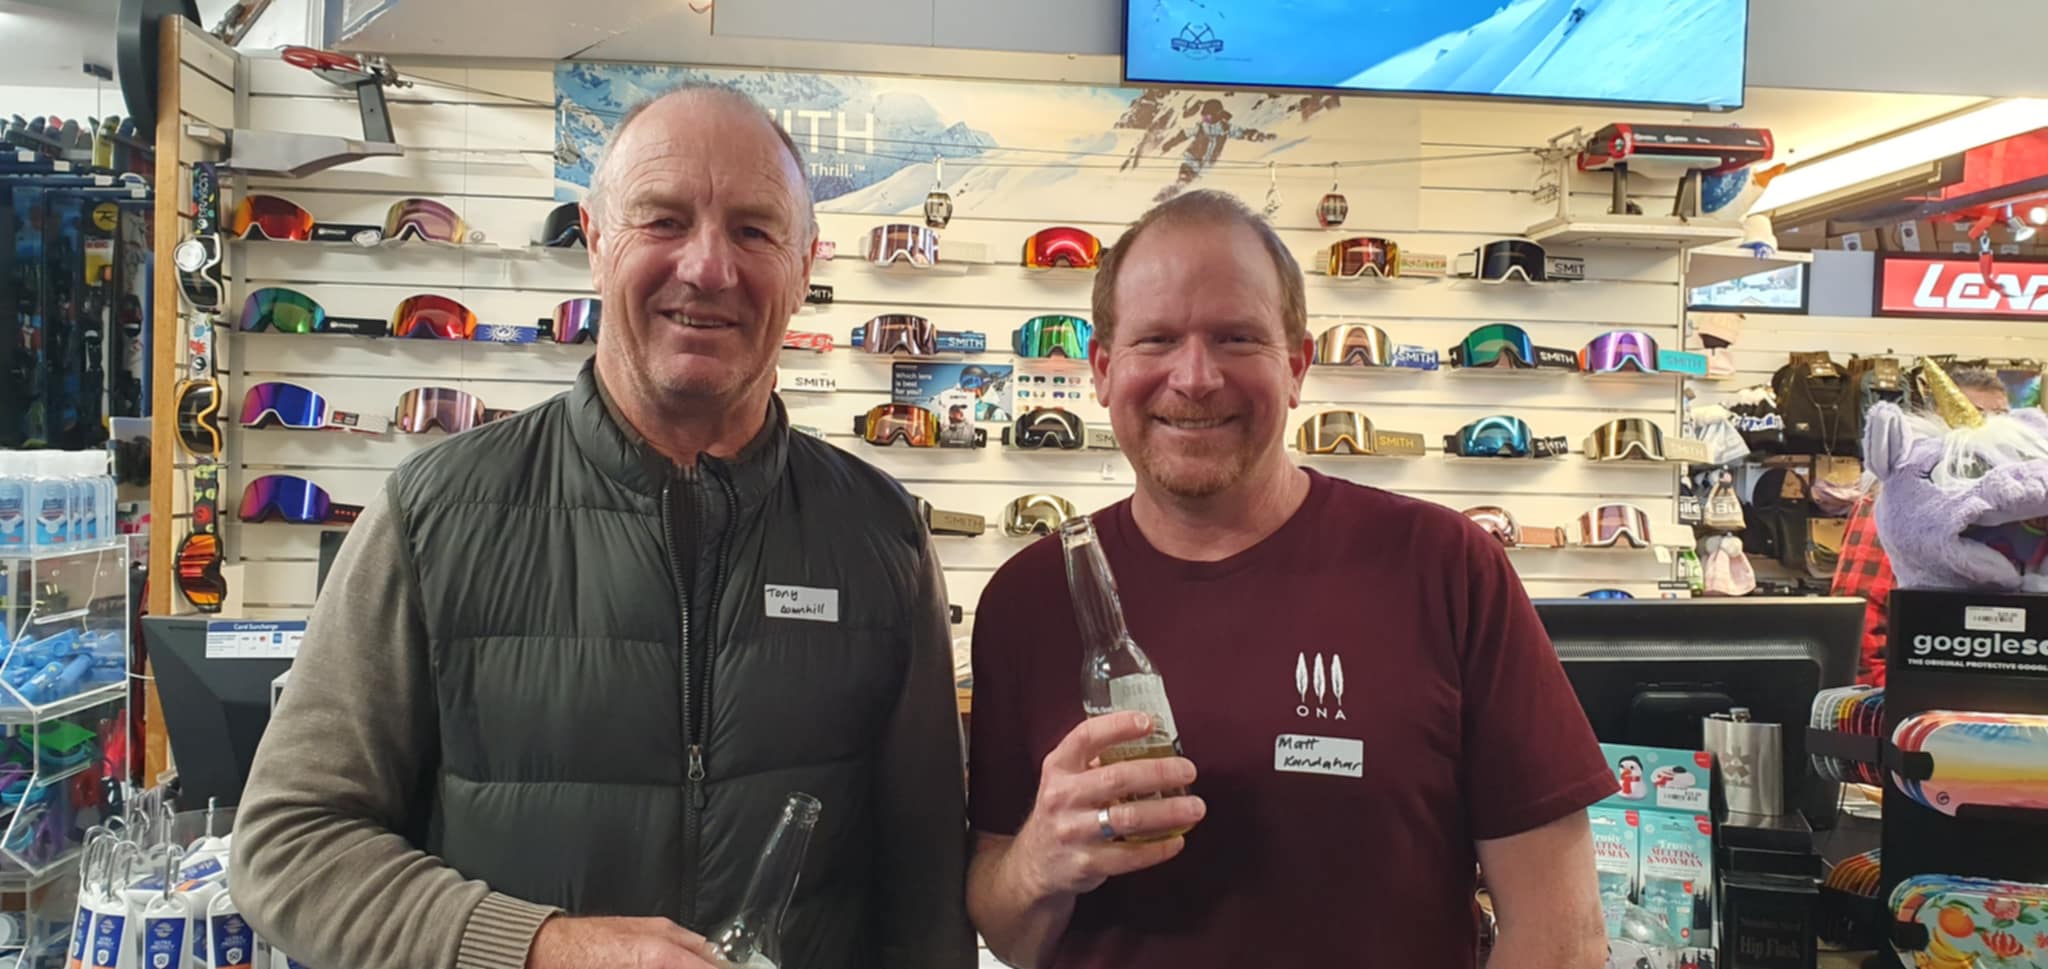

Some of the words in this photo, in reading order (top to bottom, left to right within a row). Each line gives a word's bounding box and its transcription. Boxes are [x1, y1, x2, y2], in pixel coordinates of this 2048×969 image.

[768, 108, 874, 154] ITH
[948, 337, 984, 349] SMITH
[1399, 351, 1436, 363] SMITH
[1539, 351, 1574, 364] SMITH
[1668, 357, 1702, 369] SMITH
[795, 376, 836, 388] SMITH
[1378, 436, 1415, 447] SMITH
[943, 515, 984, 527] SMITH
[766, 588, 798, 600] Tony
[249, 623, 279, 631] Surcharge
[1907, 658, 1924, 666] THE
[1925, 659, 1965, 668] ORIGINAL
[1966, 661, 2017, 670] PROTECTIVE
[1296, 705, 1346, 720] ONA
[1278, 737, 1319, 750] Matt
[1284, 755, 1362, 771] Kandahar
[1651, 847, 1700, 860] MELTING
[1646, 855, 1703, 868] SNOWMAN
